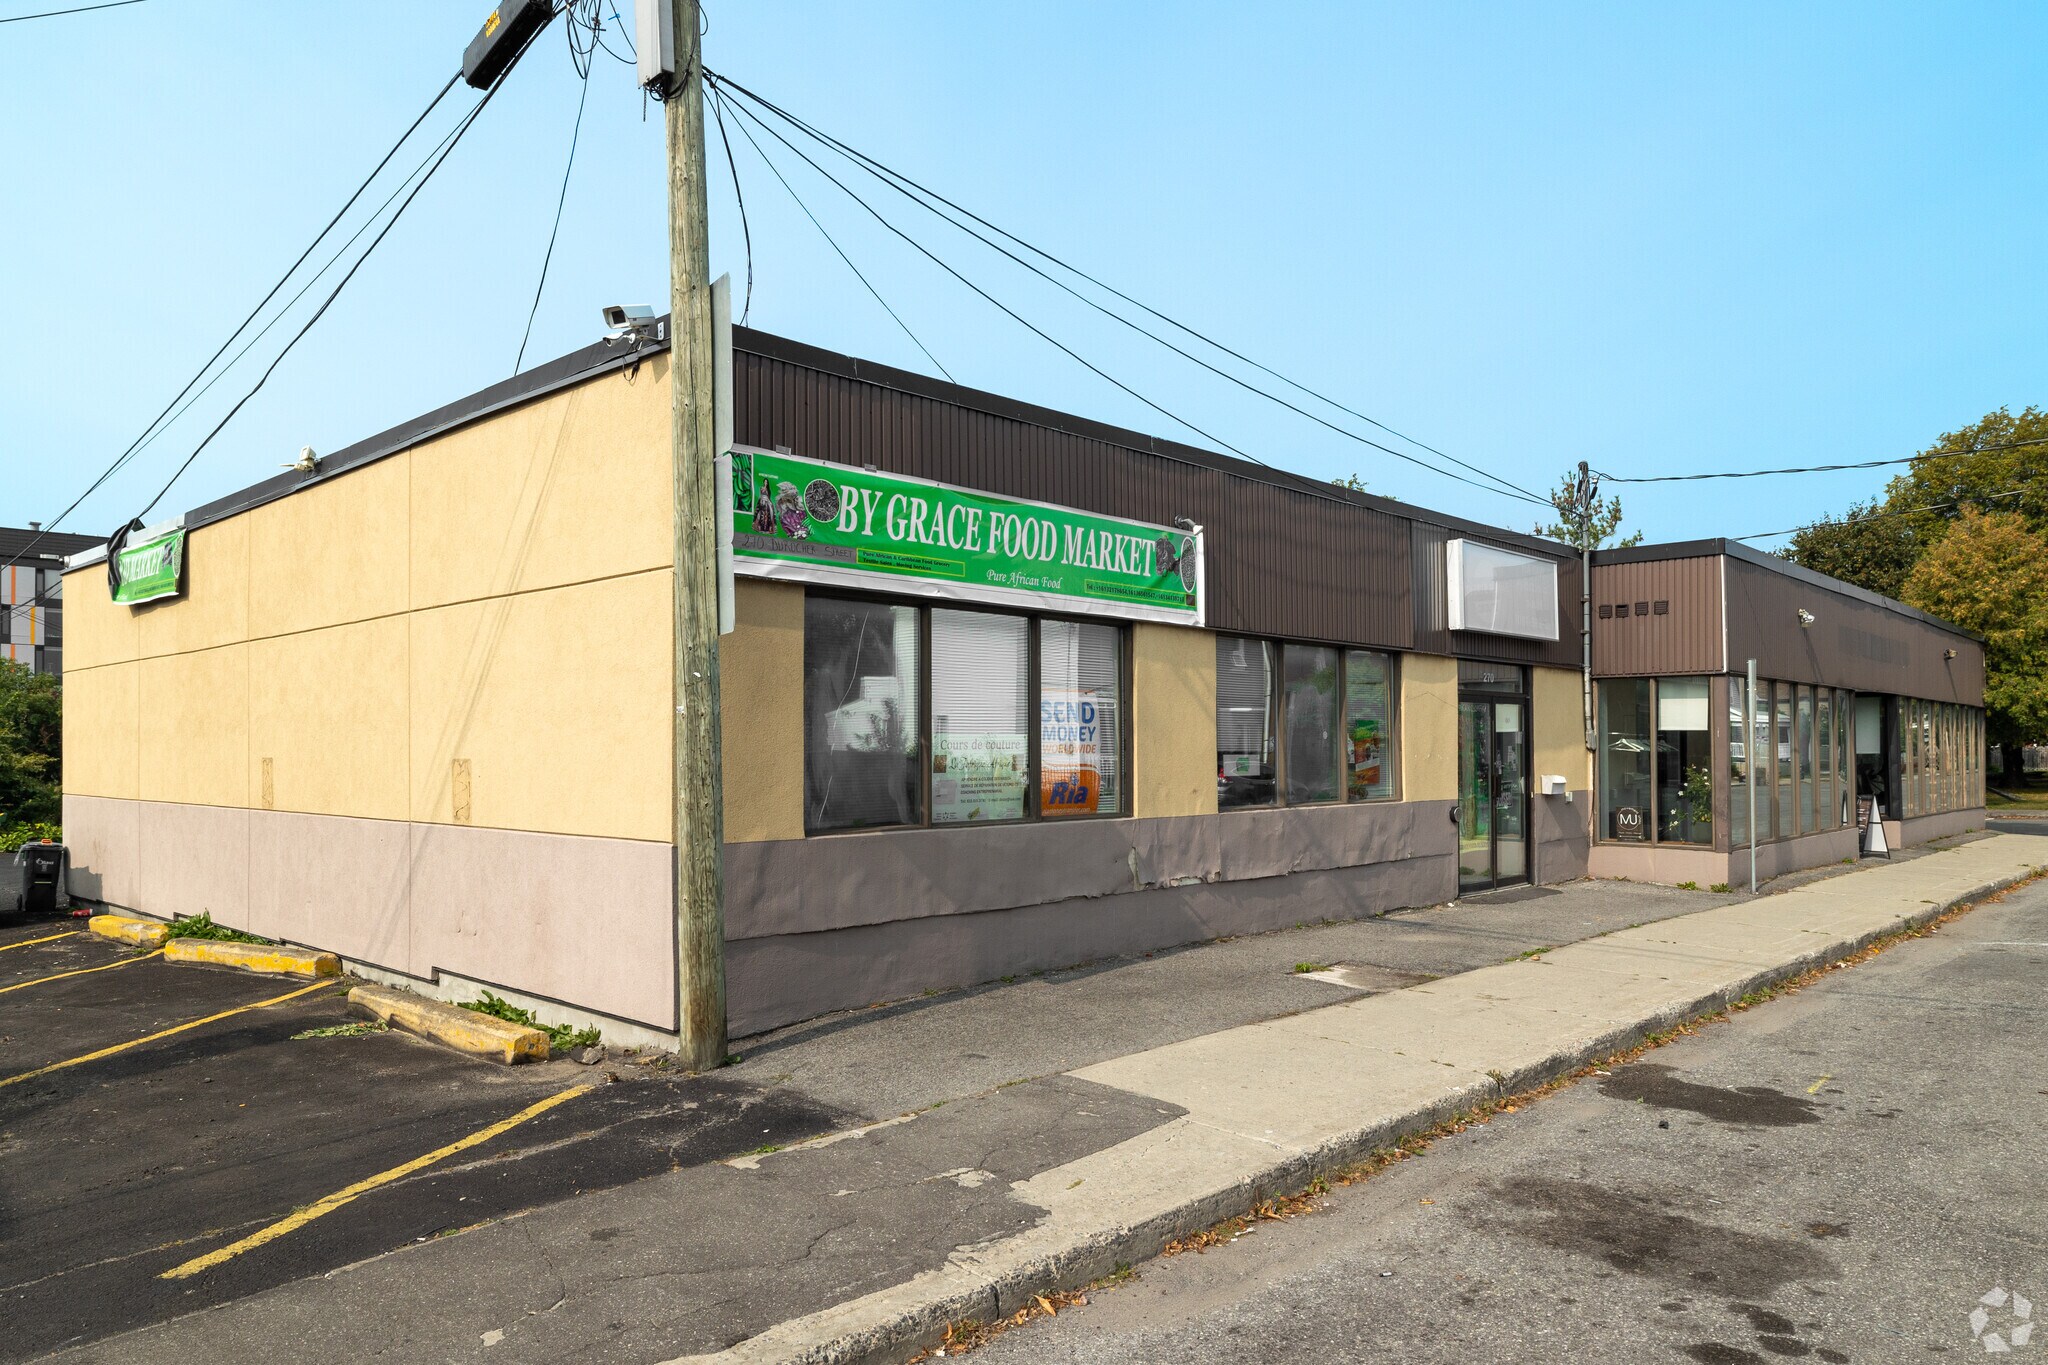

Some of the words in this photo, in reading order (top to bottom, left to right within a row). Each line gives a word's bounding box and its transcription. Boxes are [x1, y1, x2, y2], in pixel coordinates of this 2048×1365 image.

[836, 485, 883, 536] BY
[886, 493, 982, 552] GRACE
[987, 511, 1058, 562] FOOD
[1061, 524, 1156, 577] MARKET
[128, 545, 165, 583] MARKET
[986, 569, 1007, 582] Pure
[1007, 571, 1039, 588] African
[1041, 576, 1063, 589] Food
[1483, 672, 1495, 683] 270
[1041, 701, 1095, 724] SEND
[1042, 726, 1096, 742] MONEY
[940, 739, 969, 750] Cours
[971, 738, 983, 750] de
[985, 740, 1021, 750] couture
[1042, 744, 1096, 755] WORLDWIDE
[1049, 774, 1088, 805] Ria
[1620, 814, 1637, 825] MU
